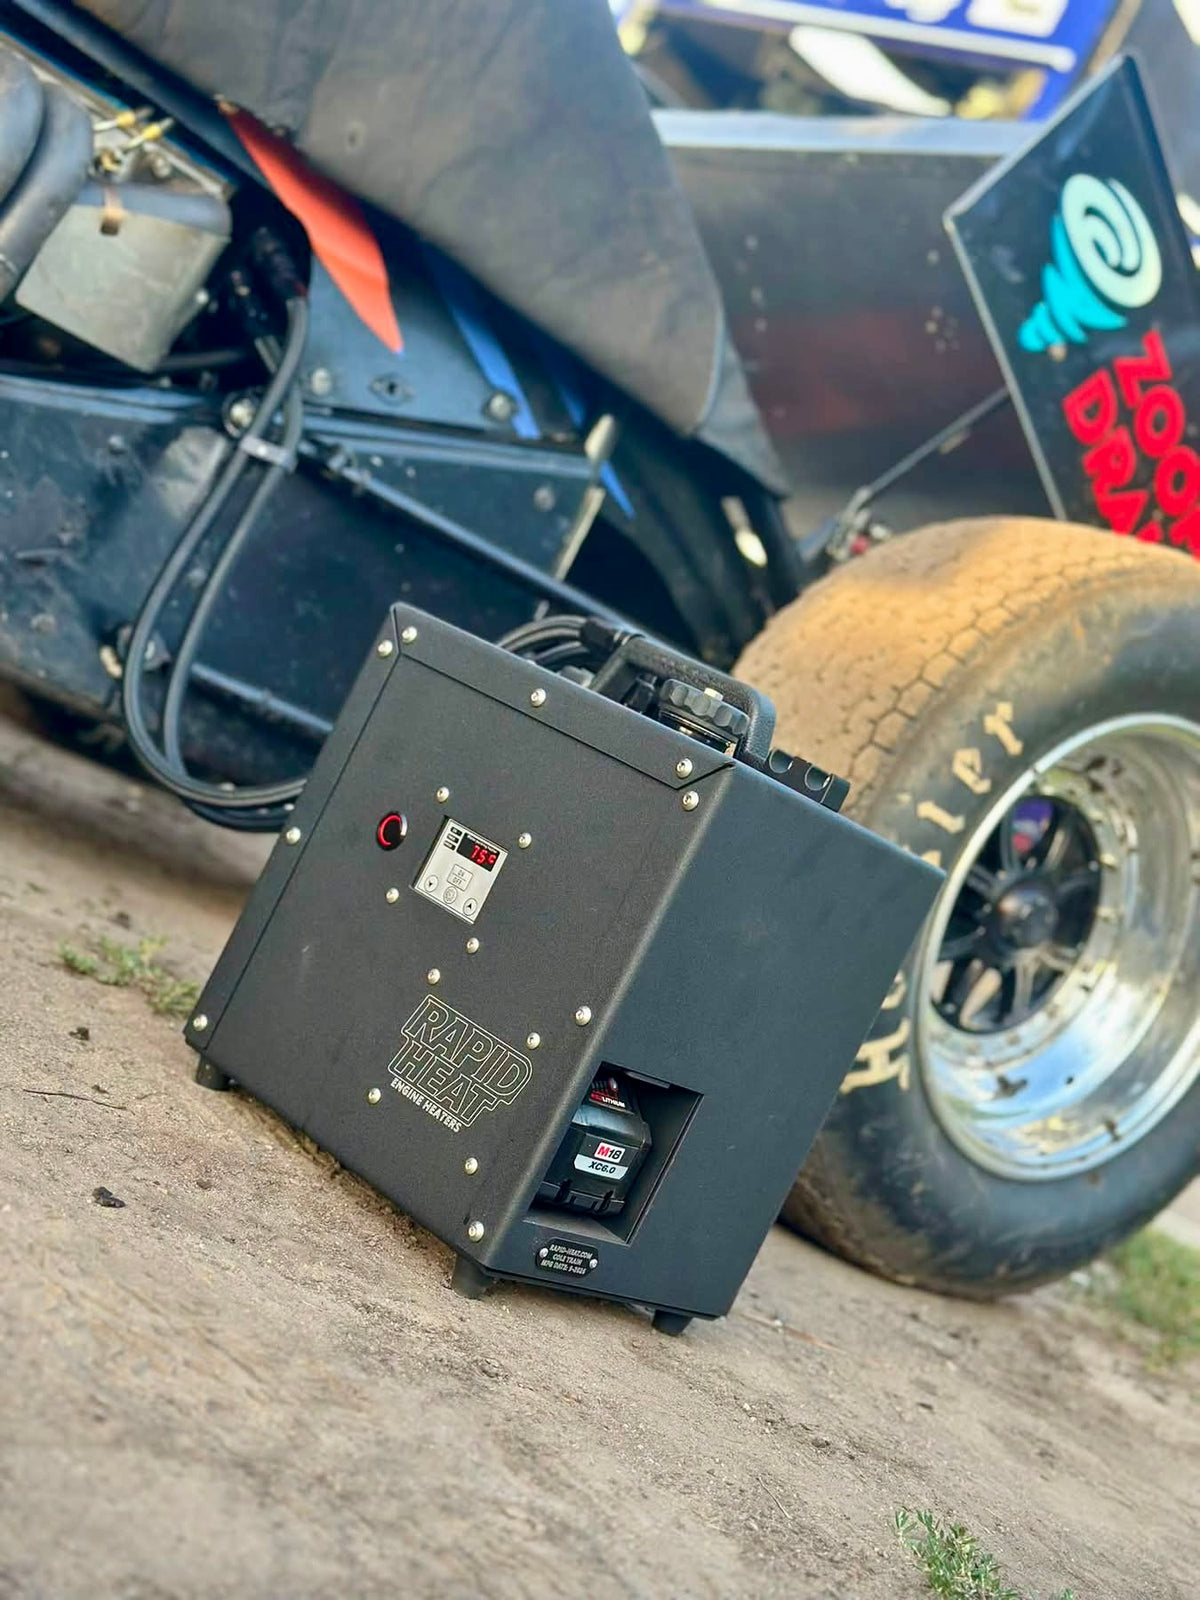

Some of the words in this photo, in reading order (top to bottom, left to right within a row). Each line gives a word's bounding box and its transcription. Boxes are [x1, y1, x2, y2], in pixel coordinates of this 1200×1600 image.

[1062, 366, 1164, 543] DRA
[394, 1040, 498, 1122] HEAT
[404, 999, 529, 1096] RAPID
[390, 1077, 425, 1106] ENGINE
[422, 1100, 463, 1133] HEATERS
[588, 1161, 617, 1174] XC6.0
[597, 1145, 623, 1160] M18
